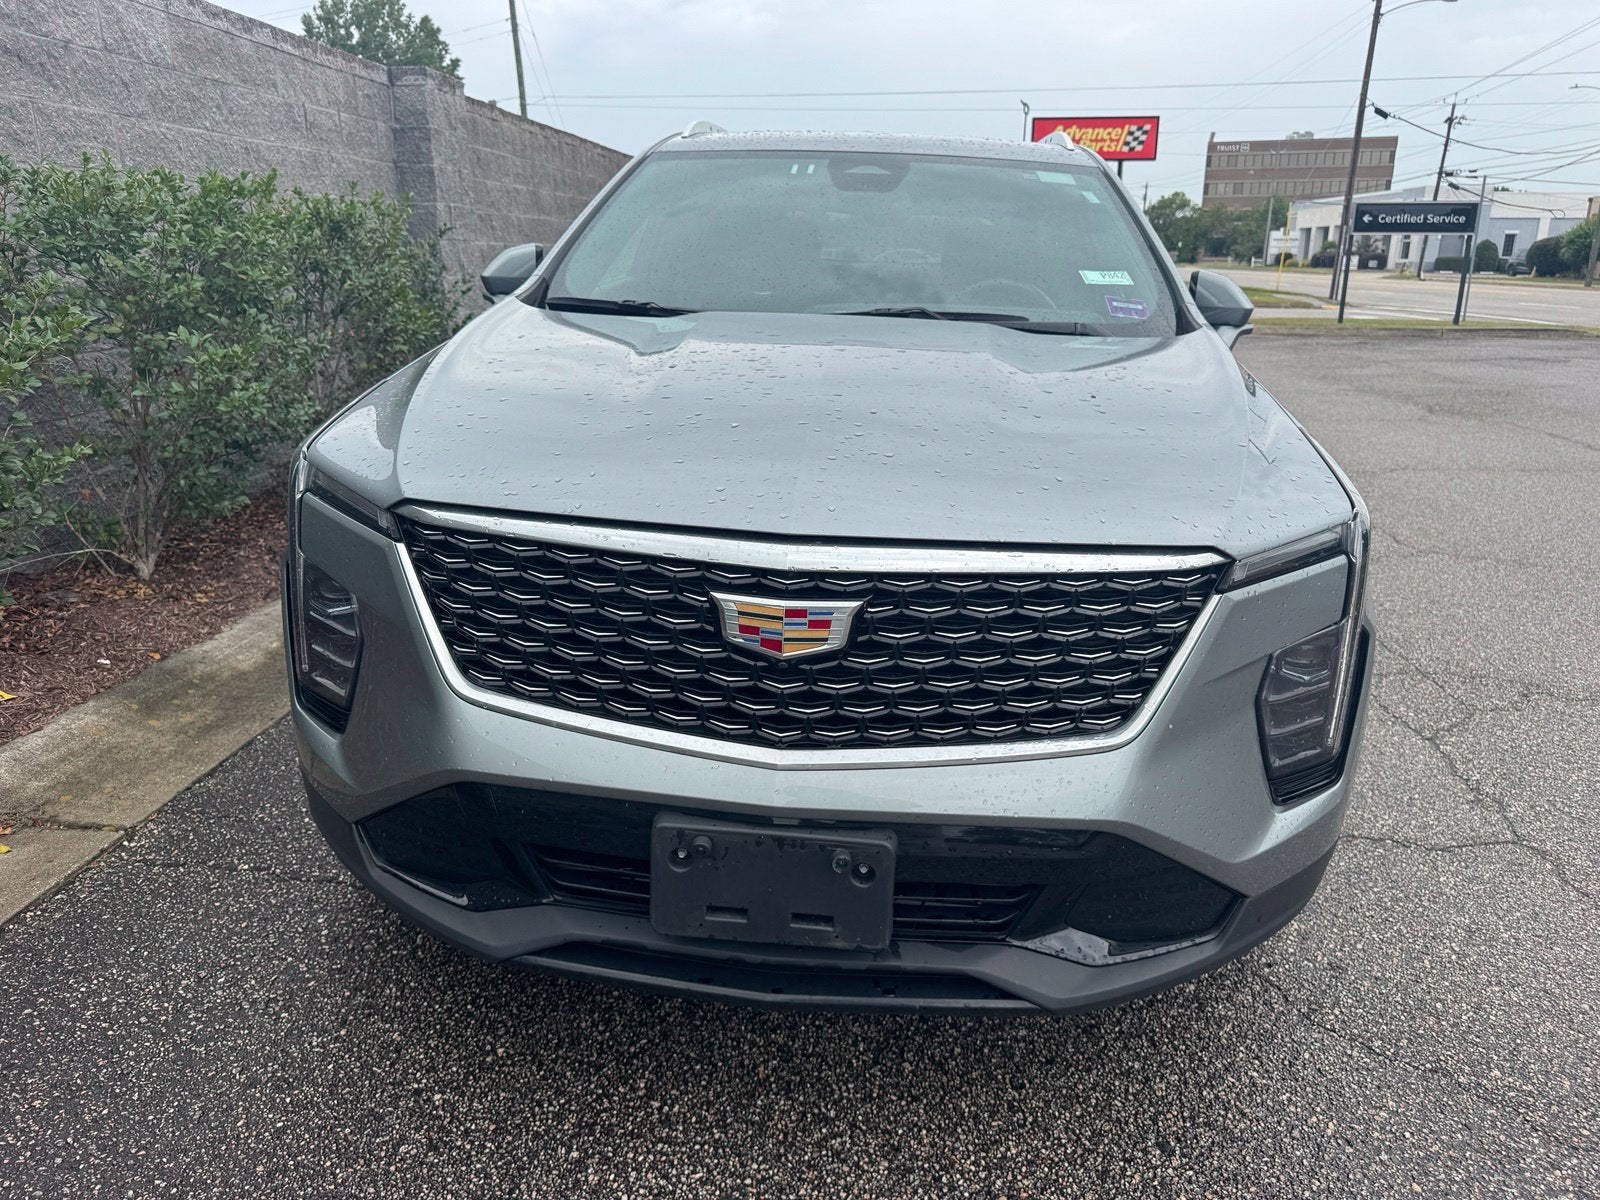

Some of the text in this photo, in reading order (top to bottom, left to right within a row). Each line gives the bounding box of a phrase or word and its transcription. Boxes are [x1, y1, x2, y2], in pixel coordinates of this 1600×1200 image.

[1216, 144, 1240, 152] TRUIST
[1378, 214, 1466, 223] Certified Service
